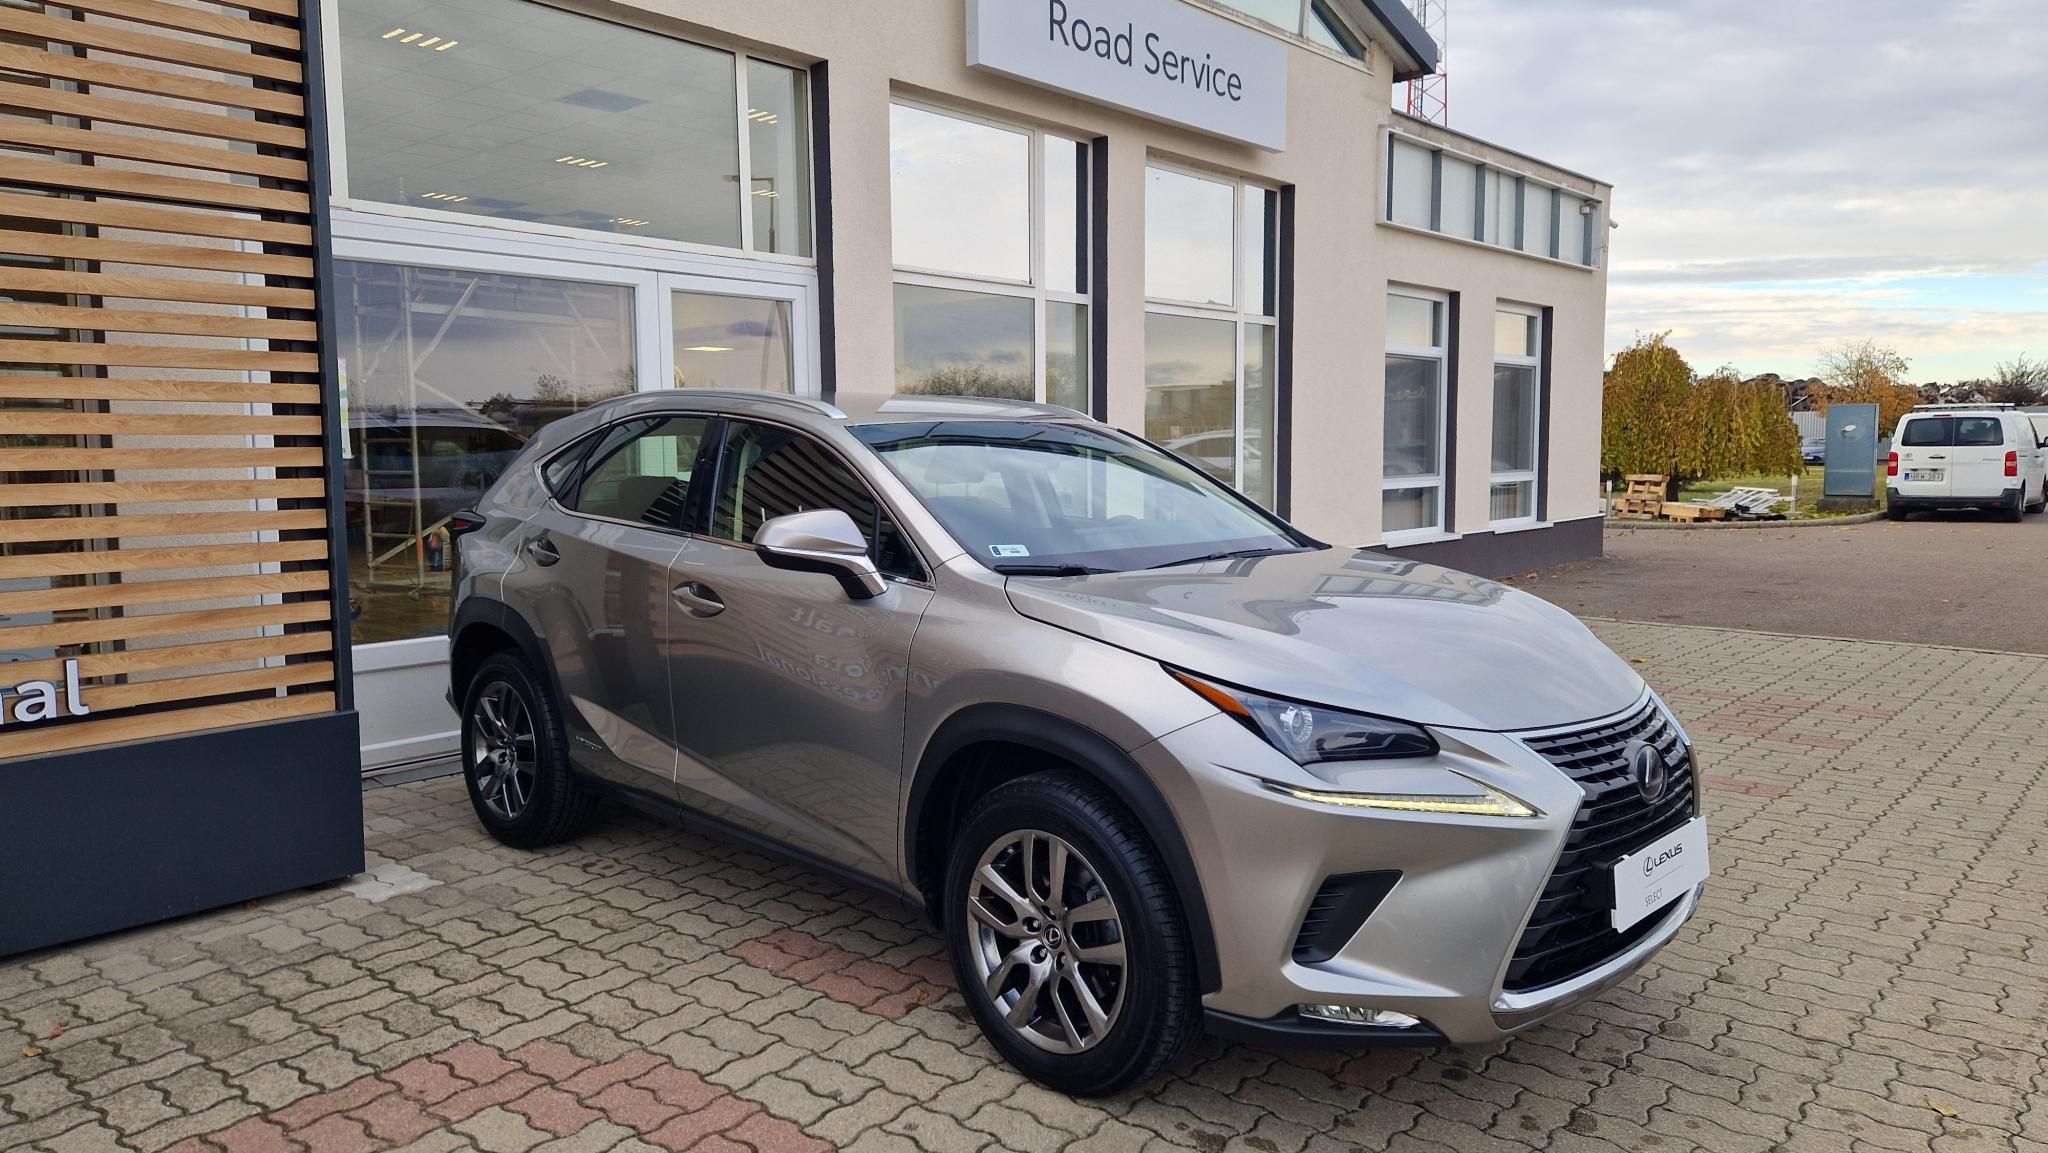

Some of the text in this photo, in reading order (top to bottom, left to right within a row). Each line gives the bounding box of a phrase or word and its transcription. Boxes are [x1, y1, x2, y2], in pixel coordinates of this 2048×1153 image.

[1049, 0, 1242, 101] Road Service
[0, 658, 90, 725] al
[1654, 843, 1682, 867] LEXUS
[1644, 888, 1662, 907] SELECT
